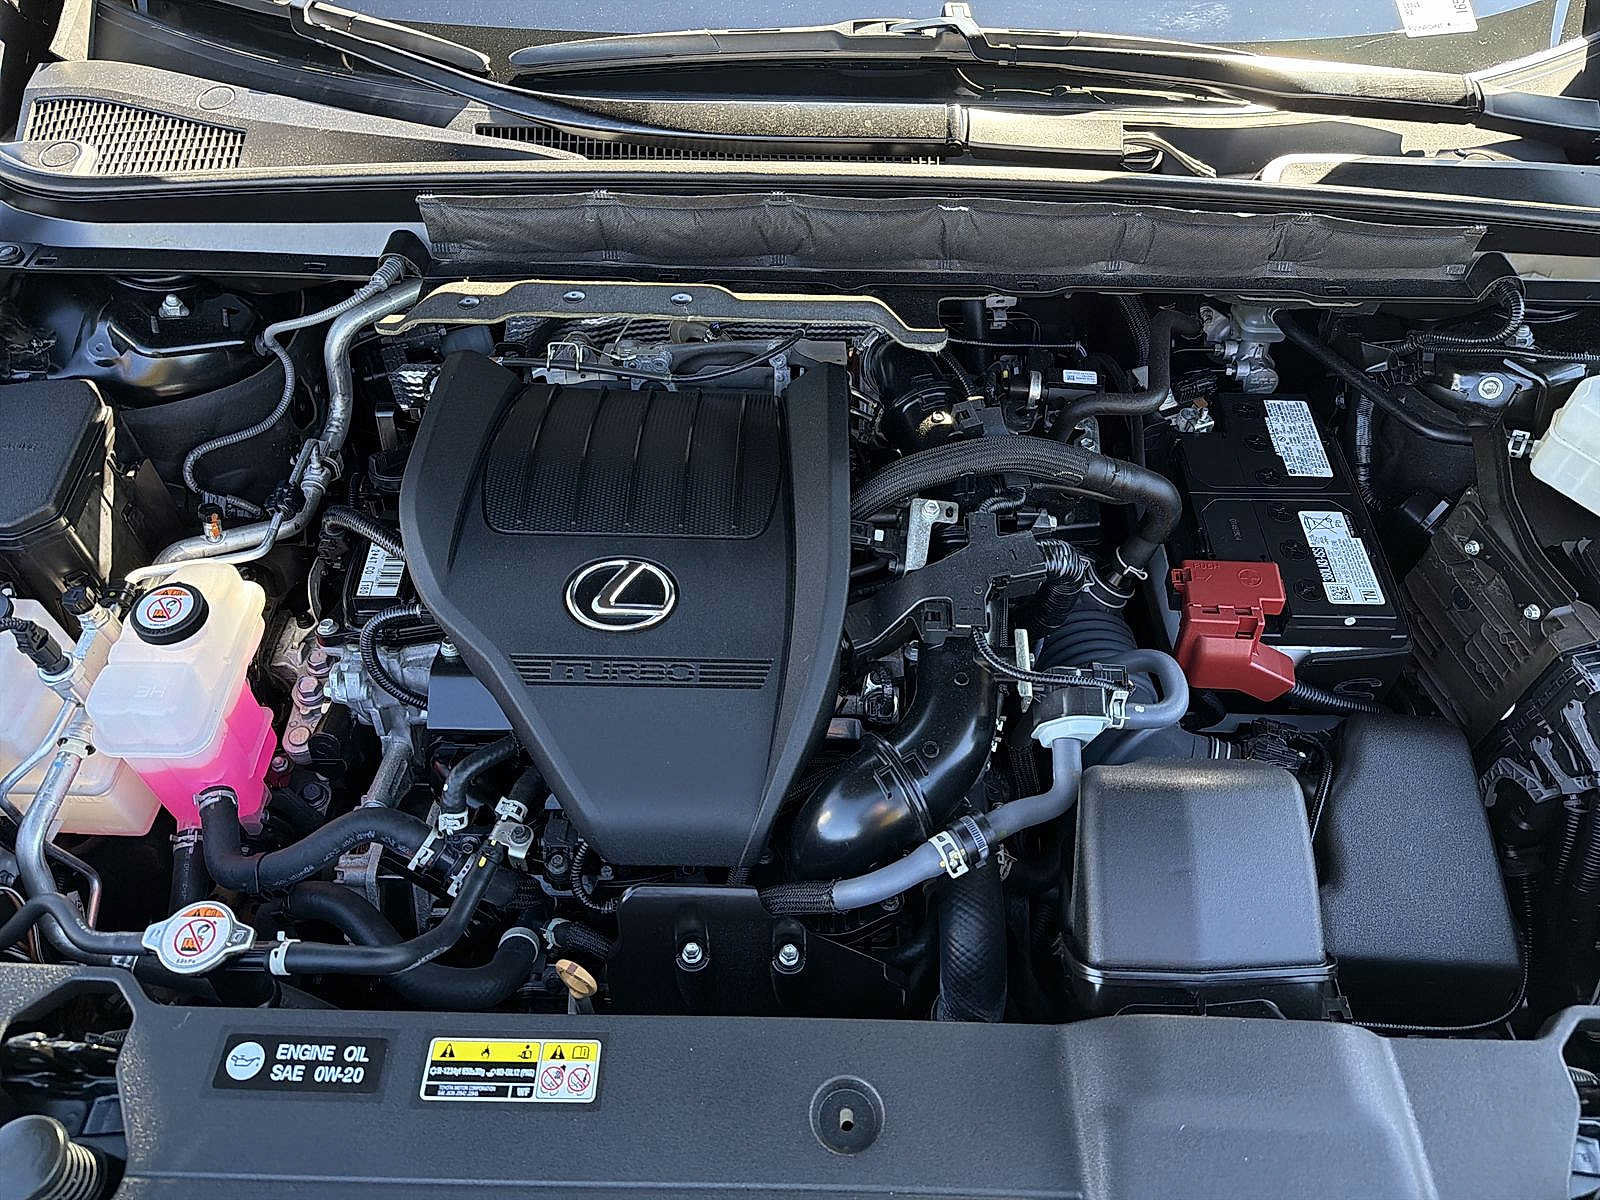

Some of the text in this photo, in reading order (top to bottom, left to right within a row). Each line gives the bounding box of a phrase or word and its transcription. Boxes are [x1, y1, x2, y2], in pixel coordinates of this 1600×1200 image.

[551, 660, 699, 682] TURBO
[275, 1043, 370, 1063] ENGINE OIL
[269, 1063, 365, 1084] SAE 0W-20
